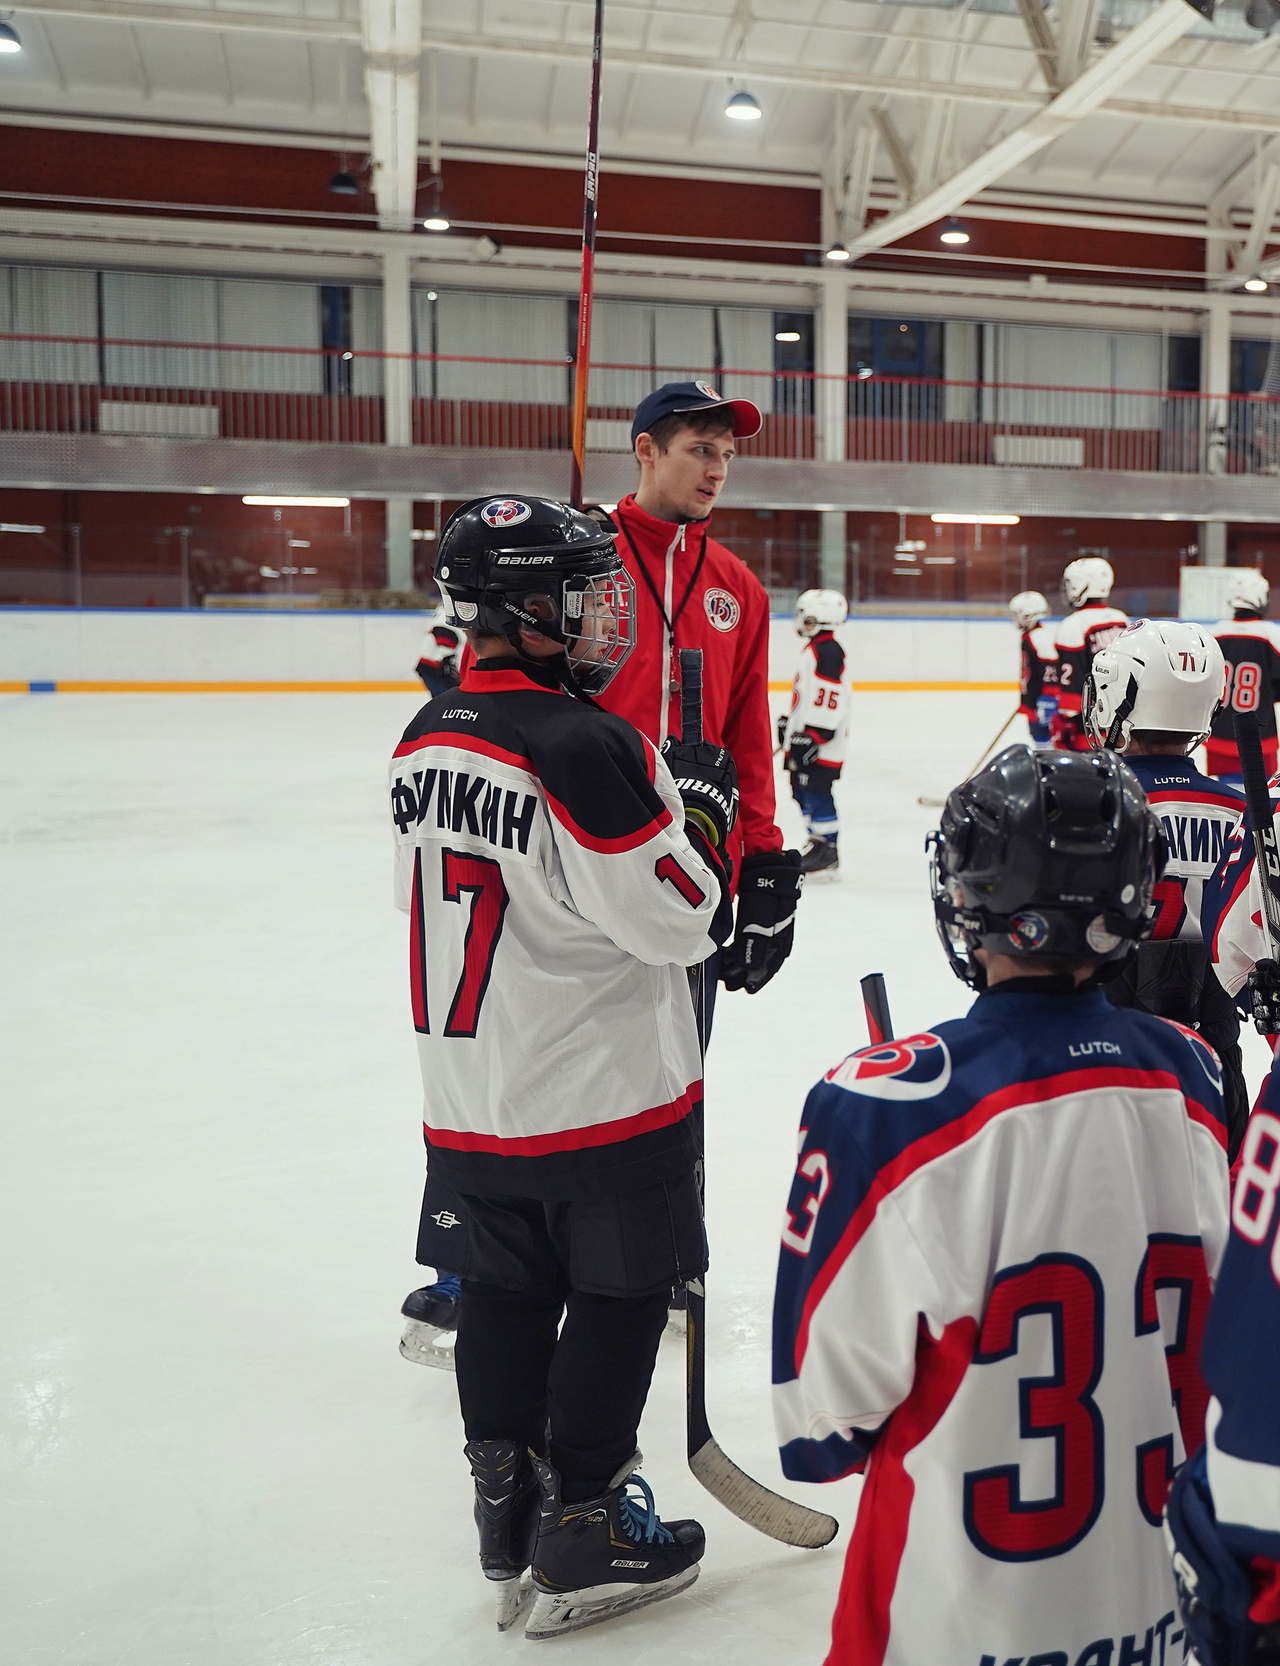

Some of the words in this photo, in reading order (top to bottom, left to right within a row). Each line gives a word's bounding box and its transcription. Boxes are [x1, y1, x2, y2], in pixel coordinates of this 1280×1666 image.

[1178, 652, 1196, 672] 71
[442, 709, 478, 722] LUTCH
[1154, 777, 1191, 785] LUTCH
[409, 846, 511, 1040] 17
[1069, 1042, 1121, 1057] LUTCH
[614, 1559, 647, 1569] BAUER
